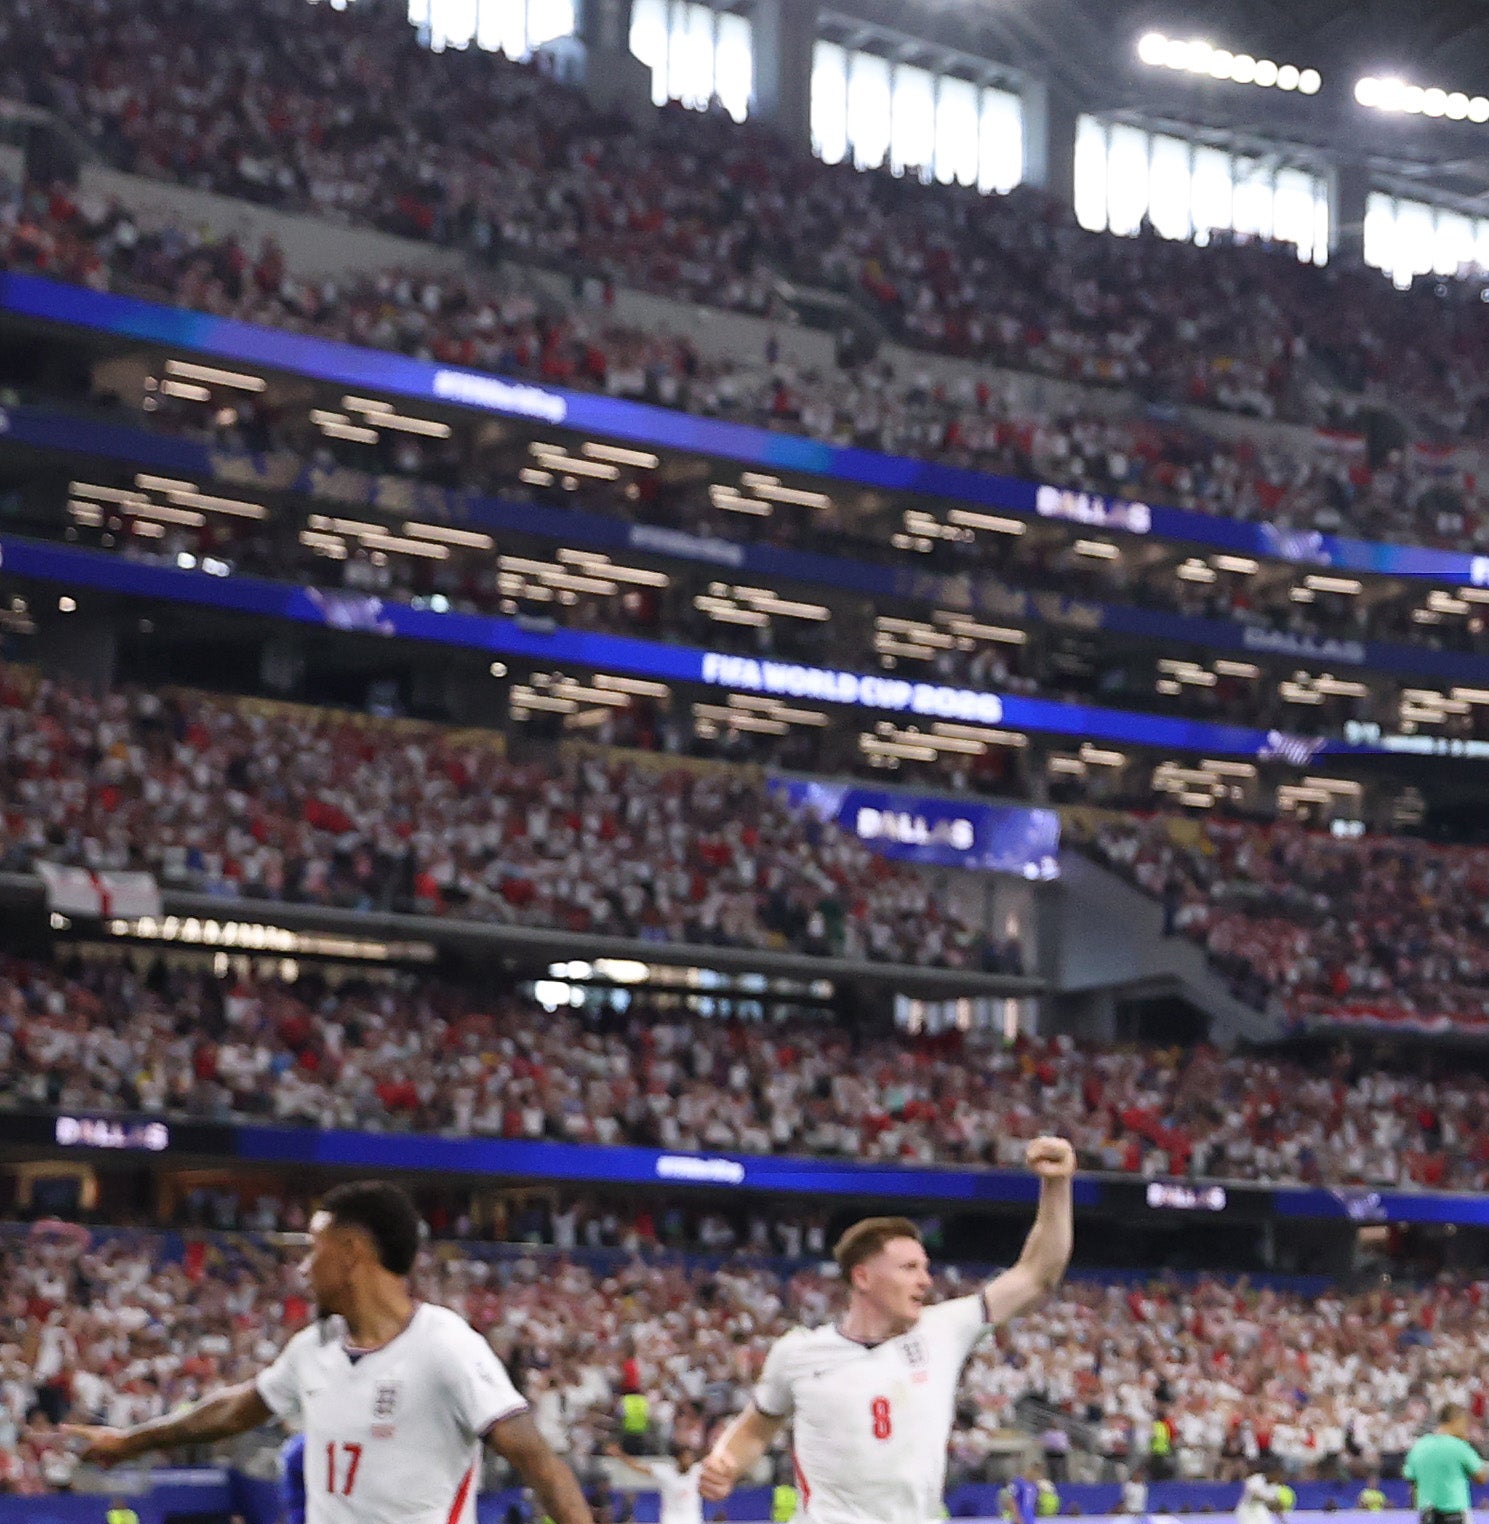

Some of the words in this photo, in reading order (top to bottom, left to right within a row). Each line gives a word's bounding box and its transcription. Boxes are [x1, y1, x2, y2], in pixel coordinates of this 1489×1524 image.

[1036, 484, 1151, 533] DALLAS
[702, 652, 761, 690] FIFA
[762, 660, 858, 703] WORLD
[858, 675, 912, 710] CUP
[912, 683, 1003, 723] 2026
[857, 807, 973, 851] DALLAS
[872, 1395, 892, 1439] 8
[326, 1440, 364, 1496] 17
